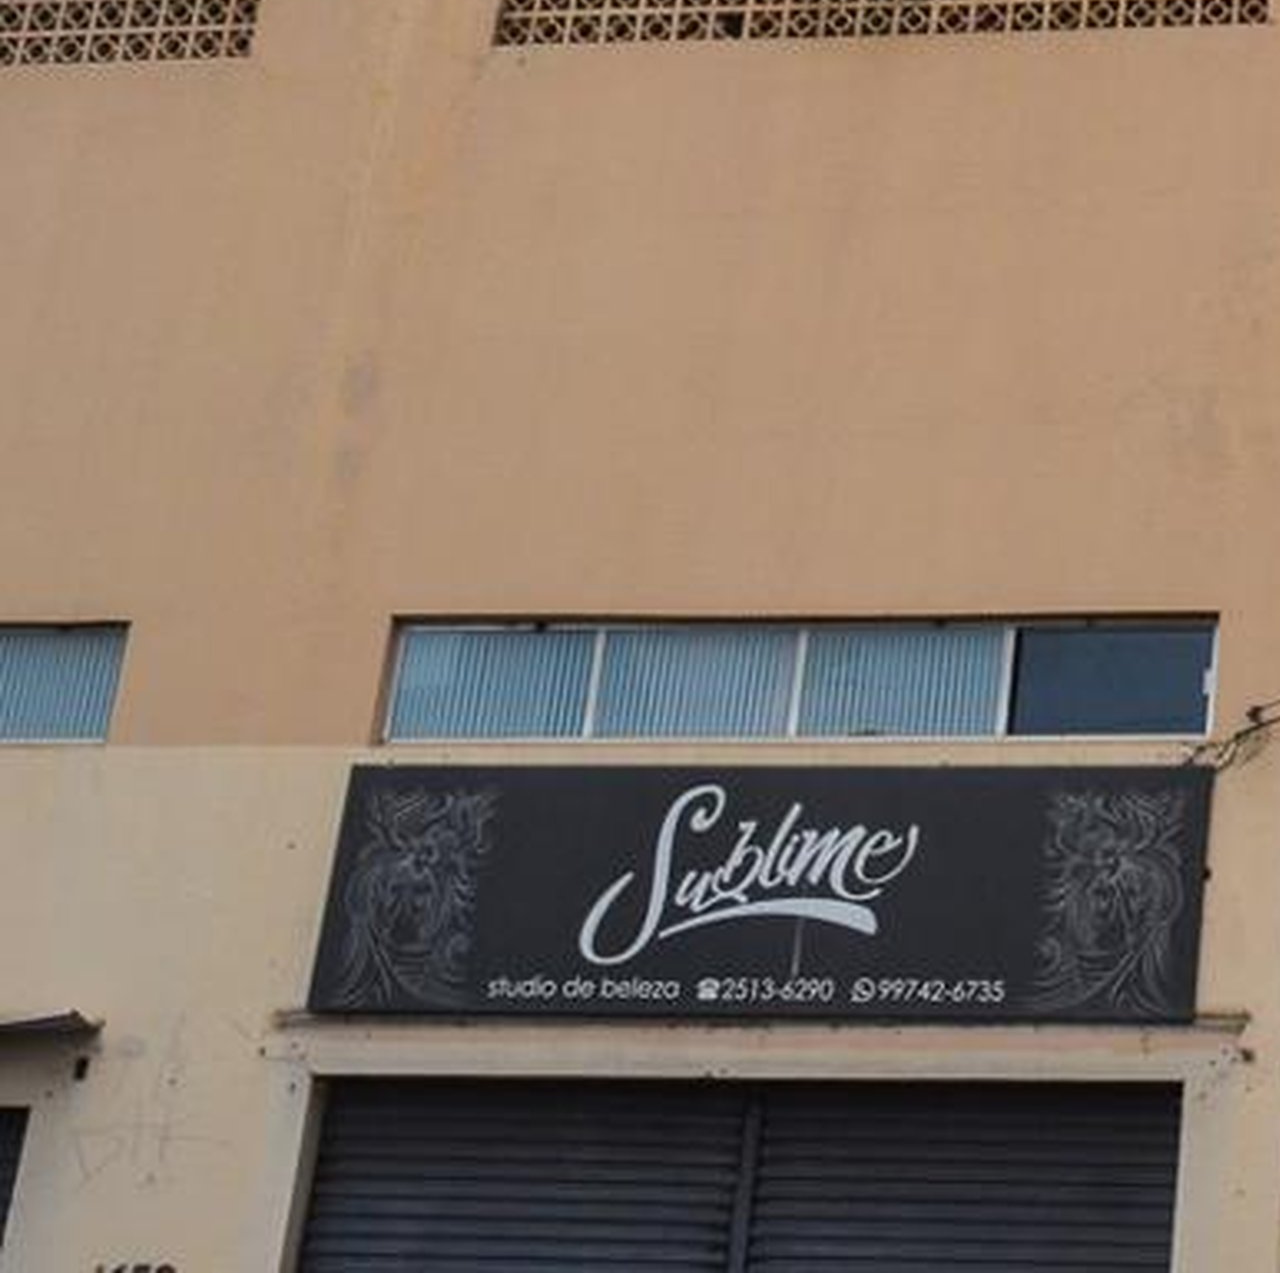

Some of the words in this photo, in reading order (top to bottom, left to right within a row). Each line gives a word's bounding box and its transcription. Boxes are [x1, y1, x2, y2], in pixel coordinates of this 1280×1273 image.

[579, 783, 919, 965] Sublime
[487, 975, 557, 999] studio
[561, 975, 595, 999] de
[601, 976, 680, 999] beleza
[721, 978, 835, 1001] 2513-6290
[877, 978, 1005, 1002] 99742-6735
